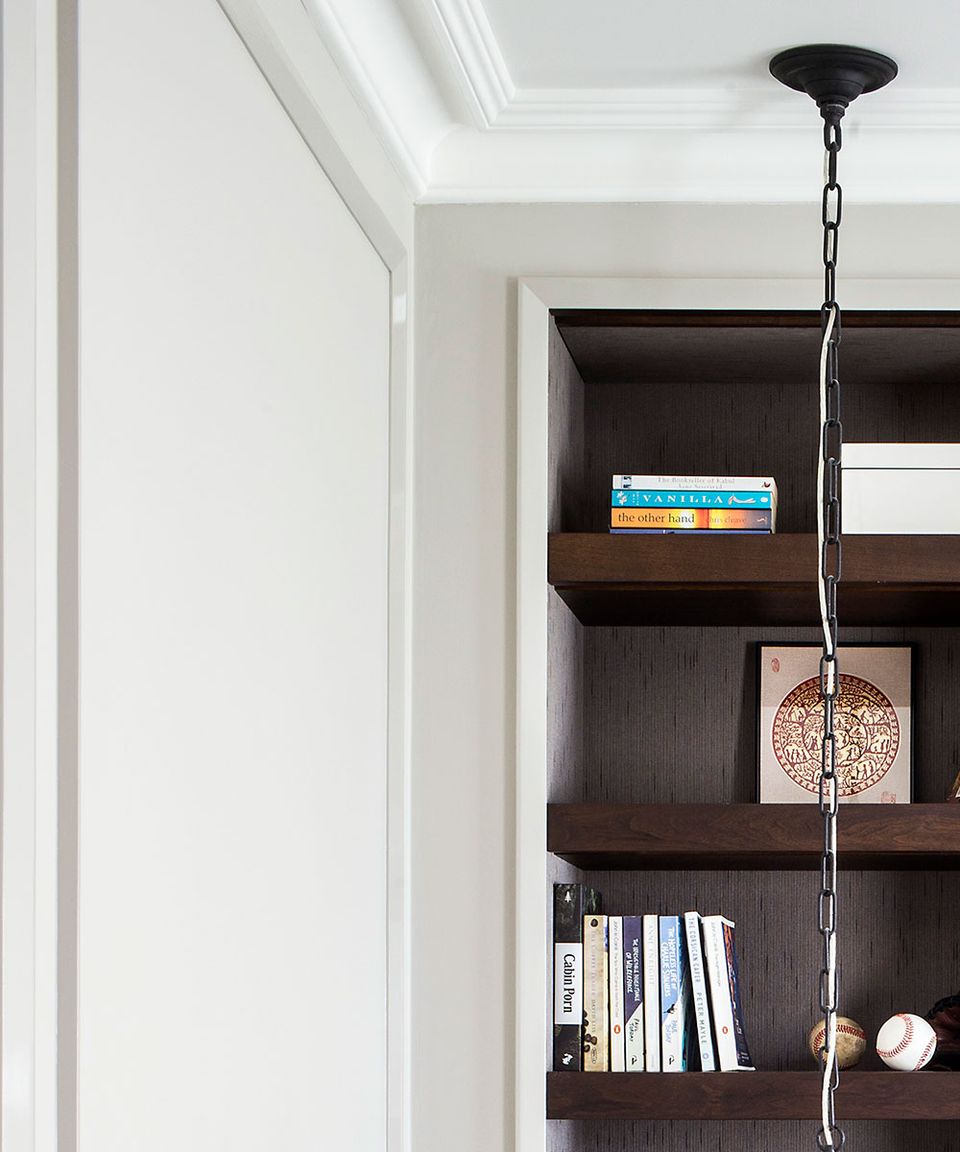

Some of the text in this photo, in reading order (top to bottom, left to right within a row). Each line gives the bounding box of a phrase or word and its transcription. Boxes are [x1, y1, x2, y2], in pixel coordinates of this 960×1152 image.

[642, 495, 723, 503] VANILLA
[618, 512, 695, 523] the other hand
[689, 931, 698, 962] CORSICAN
[563, 954, 575, 1013] Cabin Porn
[693, 963, 701, 982] CAPER
[696, 992, 707, 1044] PETER MAYLE
